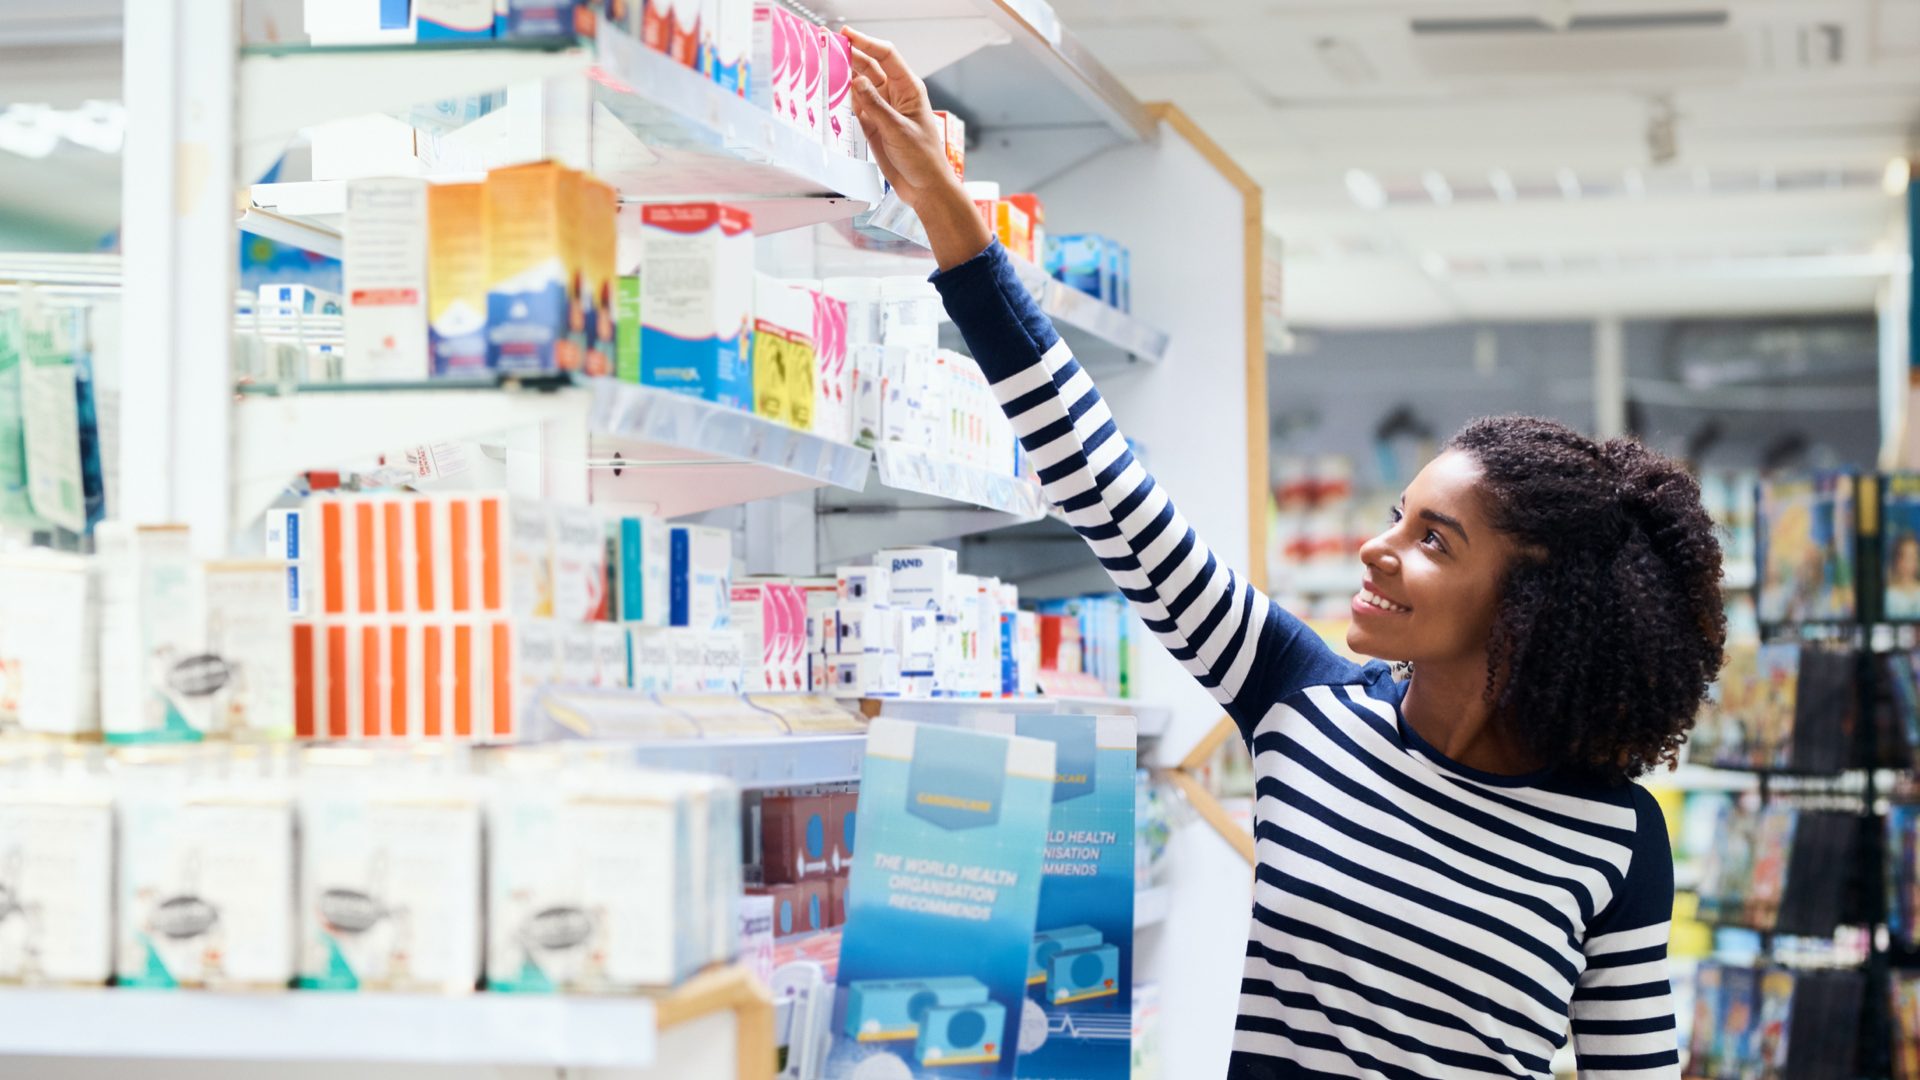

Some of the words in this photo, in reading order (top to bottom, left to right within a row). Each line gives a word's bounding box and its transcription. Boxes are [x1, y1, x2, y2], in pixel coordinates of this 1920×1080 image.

[892, 558, 923, 572] RAND
[1068, 831, 1116, 844] HEALTH
[1043, 847, 1100, 860] NISATION
[875, 854, 901, 869] THE
[905, 859, 957, 876] WORLD
[961, 868, 1017, 885] HEALTH
[1042, 863, 1097, 876] MMENDS
[890, 877, 997, 902] ORGANISATION
[890, 896, 991, 920] RECOMMENDS
